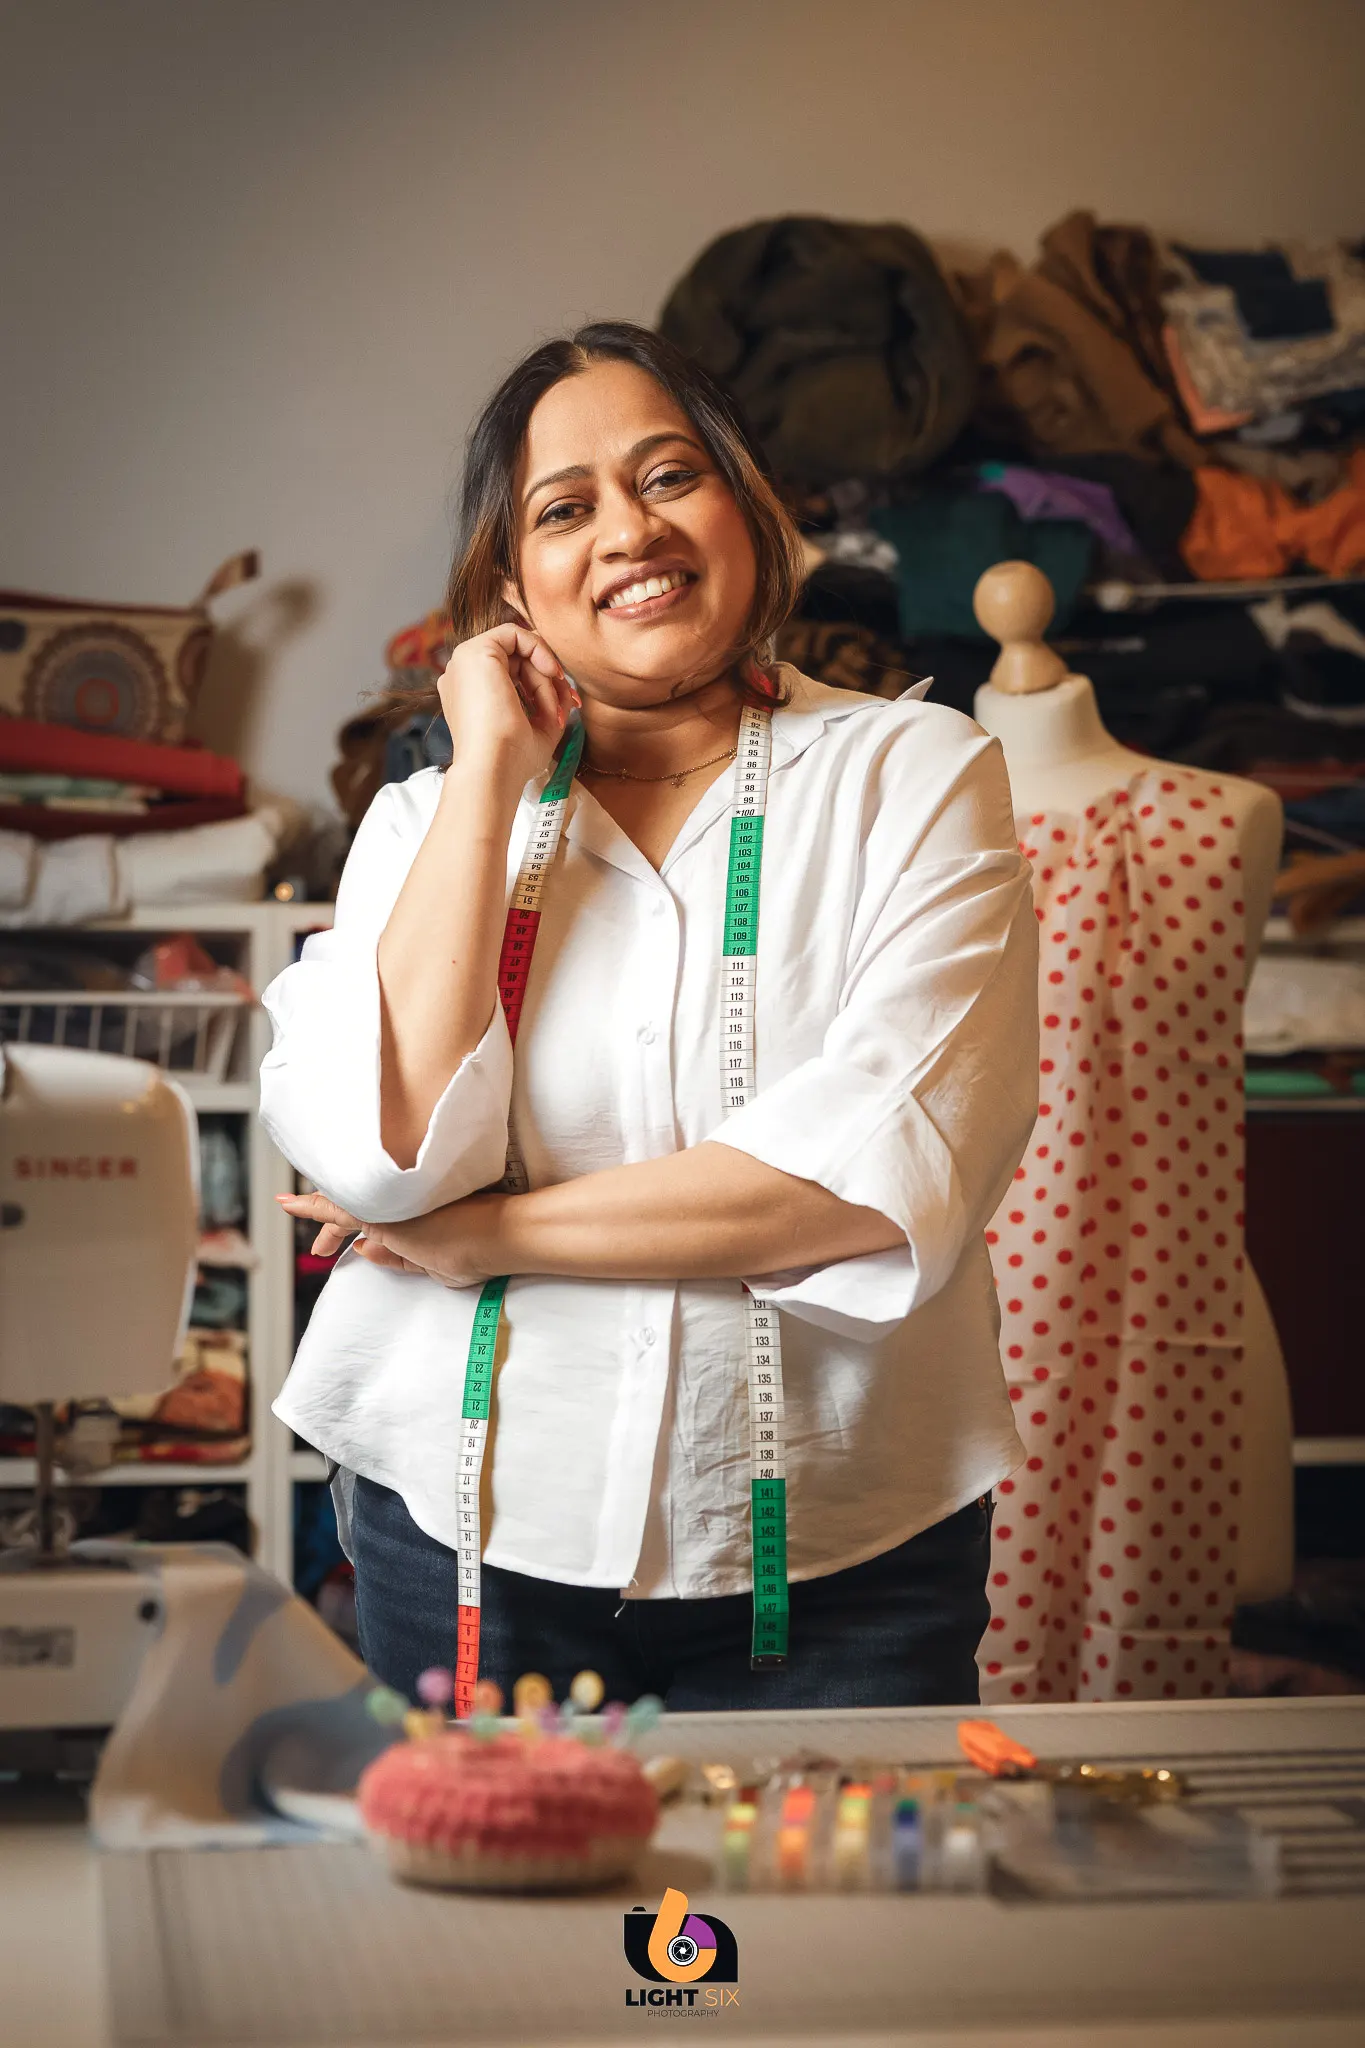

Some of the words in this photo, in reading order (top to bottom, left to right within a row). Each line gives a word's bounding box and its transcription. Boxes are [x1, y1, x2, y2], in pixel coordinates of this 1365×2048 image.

[519, 911, 530, 919] 50
[733, 932, 747, 940] 109
[513, 942, 524, 950] 48
[732, 947, 745, 955] 110
[510, 957, 520, 966] 47
[731, 977, 744, 985] 112
[504, 989, 514, 998] 45
[730, 993, 744, 1001] 113
[730, 1008, 743, 1016] 114
[729, 1024, 742, 1033] 115
[729, 1040, 742, 1050] 116
[729, 1059, 742, 1068] 117
[730, 1077, 743, 1086] 118
[731, 1096, 745, 1105] 119
[16, 1156, 138, 1180] SINGER
[753, 1300, 766, 1308] 131
[483, 1309, 492, 1318] 26
[754, 1318, 768, 1327] 132
[480, 1327, 488, 1336] 25
[755, 1336, 769, 1345] 133
[478, 1346, 486, 1355] 24
[756, 1355, 770, 1364] 134
[475, 1364, 484, 1373] 23
[757, 1374, 771, 1383] 135
[473, 1383, 482, 1392] 22
[758, 1393, 772, 1402] 136
[472, 1401, 480, 1411] 21
[760, 1412, 773, 1421] 137
[470, 1420, 479, 1429] 20
[760, 1431, 774, 1440] 138
[468, 1439, 475, 1447] 19
[760, 1450, 774, 1459] 139
[465, 1457, 473, 1466] 18
[760, 1469, 774, 1478] 140
[463, 1476, 470, 1485] 17
[760, 1488, 774, 1497] 141
[463, 1495, 470, 1504] 16
[761, 1507, 775, 1516] 142
[464, 1514, 471, 1523] 15
[761, 1526, 775, 1536] 143
[465, 1532, 472, 1541] 14
[761, 1545, 775, 1555] 144
[465, 1551, 472, 1560] 13
[762, 1564, 776, 1574] 145
[466, 1570, 472, 1579] 12
[762, 1584, 777, 1593] 146
[466, 1589, 472, 1598] 11
[466, 1607, 472, 1616] 10
[763, 1603, 777, 1612] 147
